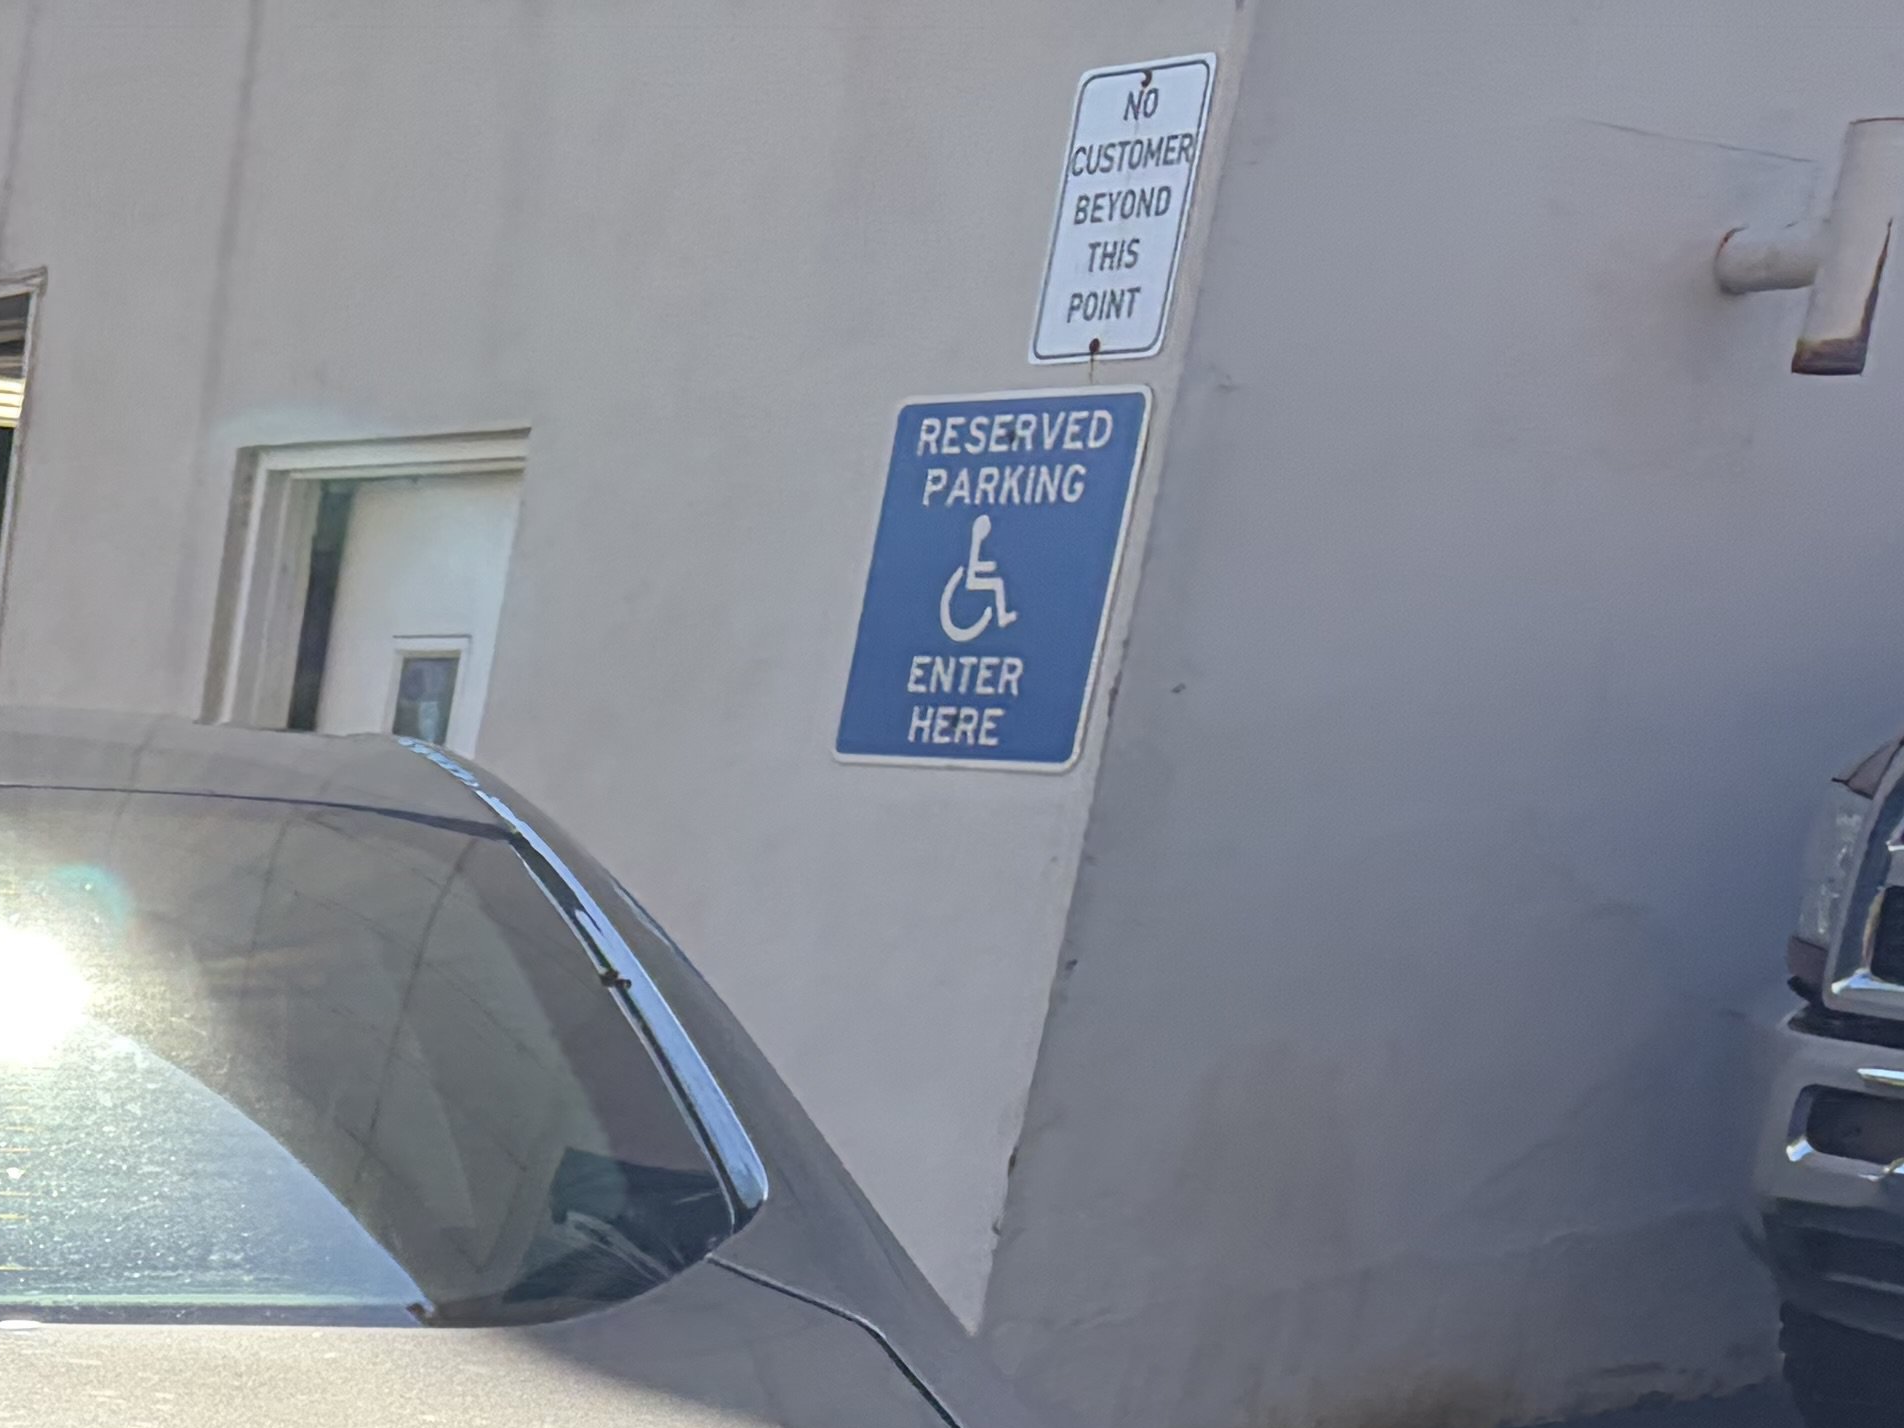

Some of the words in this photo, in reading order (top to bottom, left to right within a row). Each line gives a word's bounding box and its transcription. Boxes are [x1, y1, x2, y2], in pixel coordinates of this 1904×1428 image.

[1123, 87, 1159, 121] NO
[1071, 132, 1193, 177] CUSTOMER
[1073, 186, 1172, 225] BEYOND
[1087, 238, 1140, 273] THIS
[1065, 286, 1141, 323] POINT
[917, 409, 1113, 456] RESERVED
[922, 464, 1087, 507] PARKING
[907, 656, 1024, 696] ENTER
[907, 705, 1005, 746] HERE
